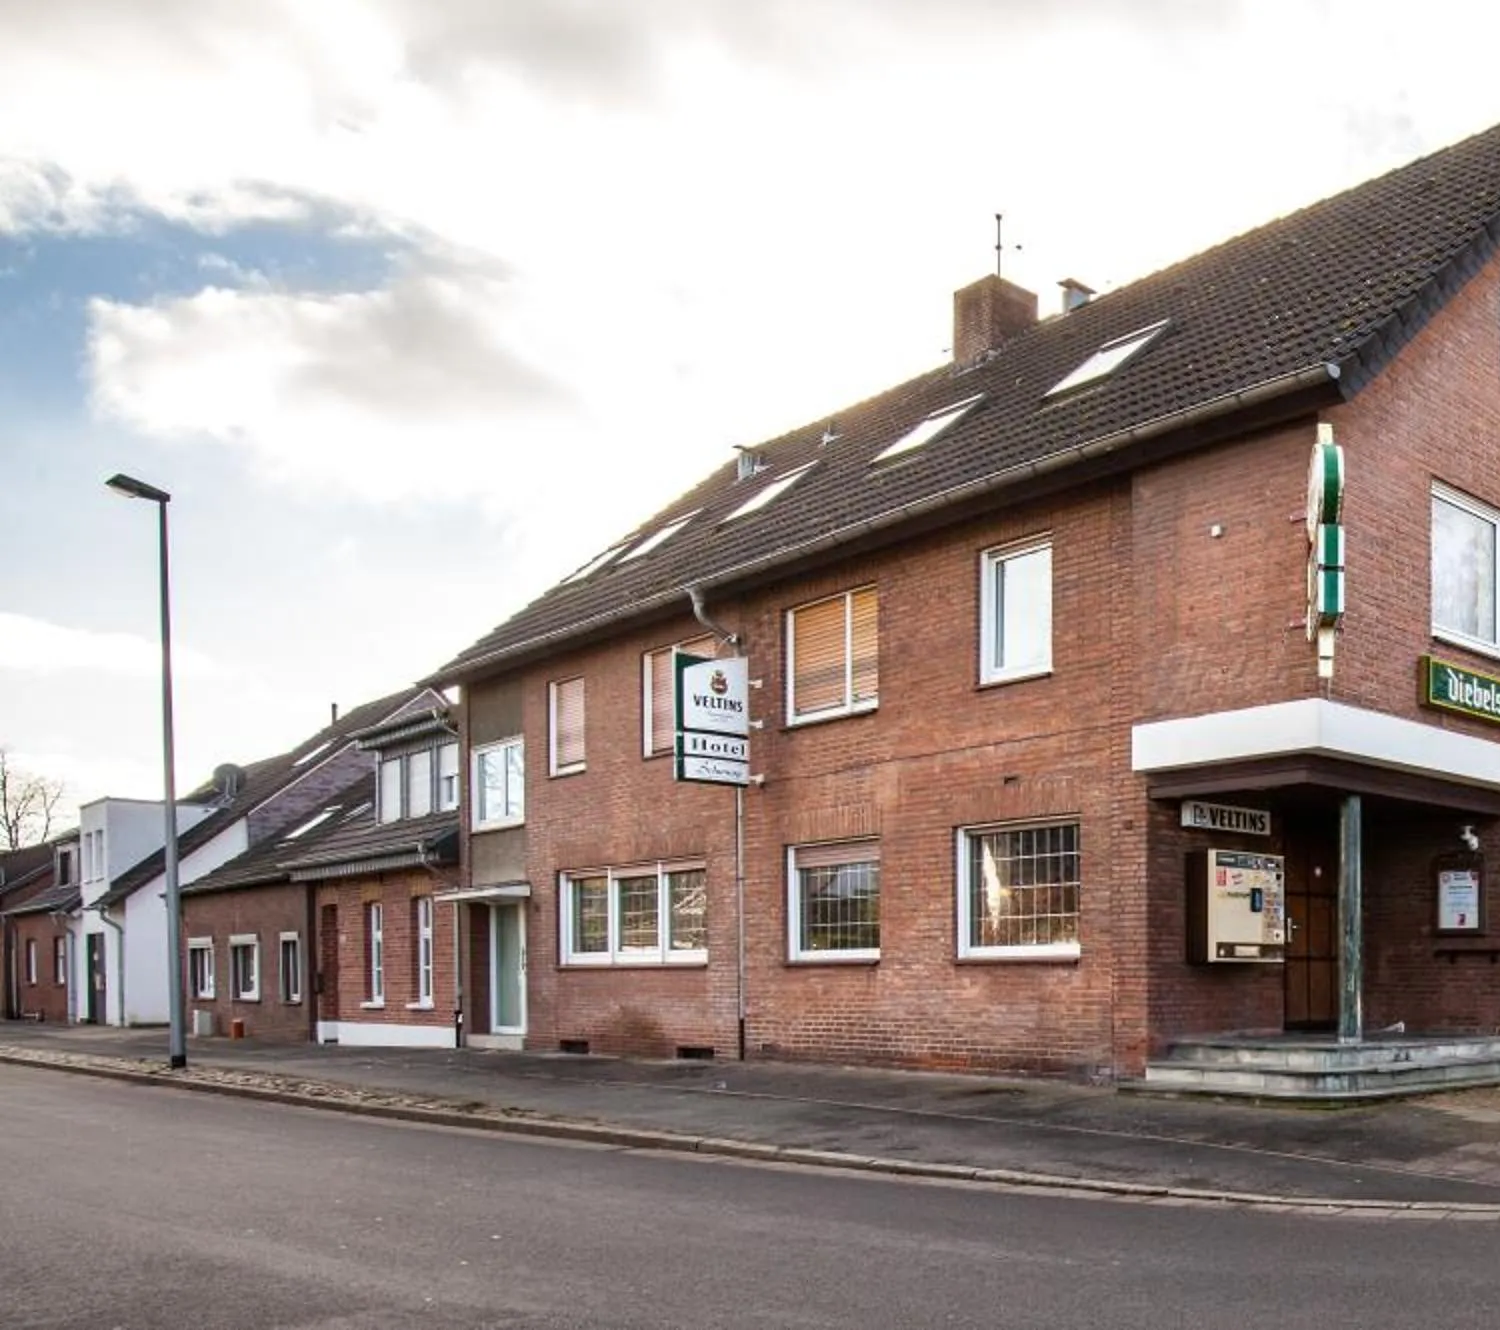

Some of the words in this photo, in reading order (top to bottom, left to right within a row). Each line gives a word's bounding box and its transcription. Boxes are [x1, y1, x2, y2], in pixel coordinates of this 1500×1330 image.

[693, 695, 743, 712] VELTINS
[691, 738, 745, 756] Hotel
[1209, 806, 1266, 832] VELTINS
